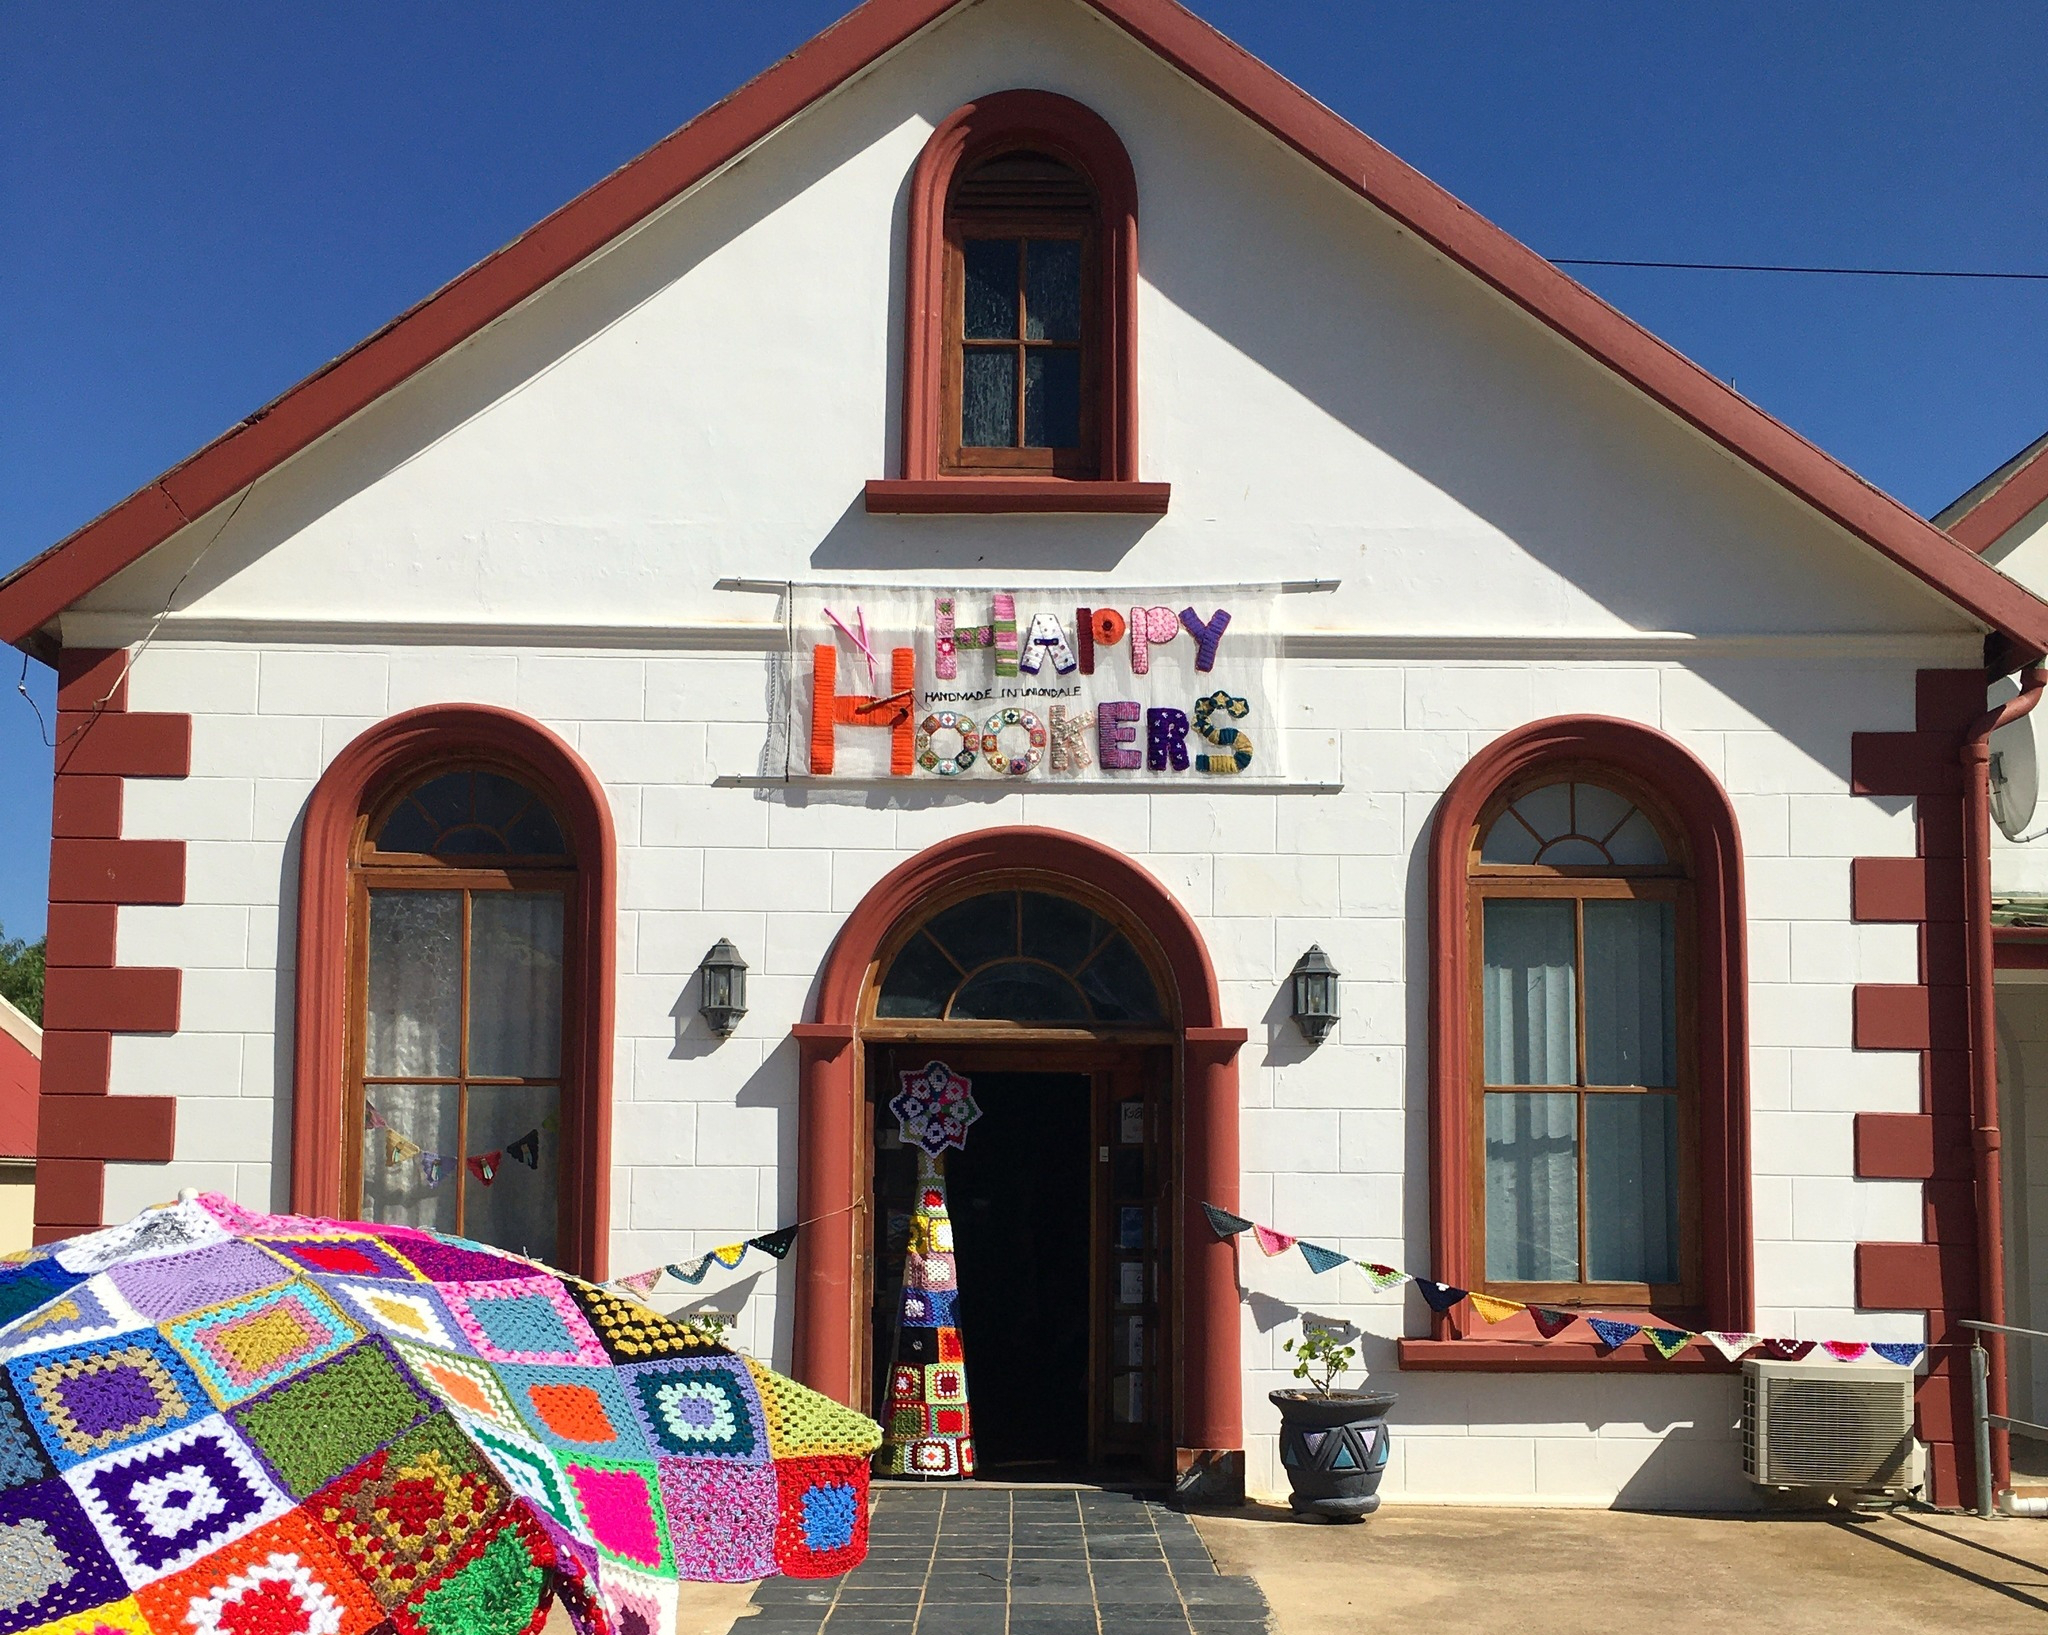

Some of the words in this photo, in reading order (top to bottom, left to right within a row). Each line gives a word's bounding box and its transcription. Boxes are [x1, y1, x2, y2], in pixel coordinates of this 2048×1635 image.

[935, 594, 1231, 679] HAPPY
[811, 644, 1253, 776] HOOKERS
[925, 688, 992, 703] HANDMADE
[1001, 688, 1018, 698] IN
[1020, 686, 1081, 698] UNIONDALE
